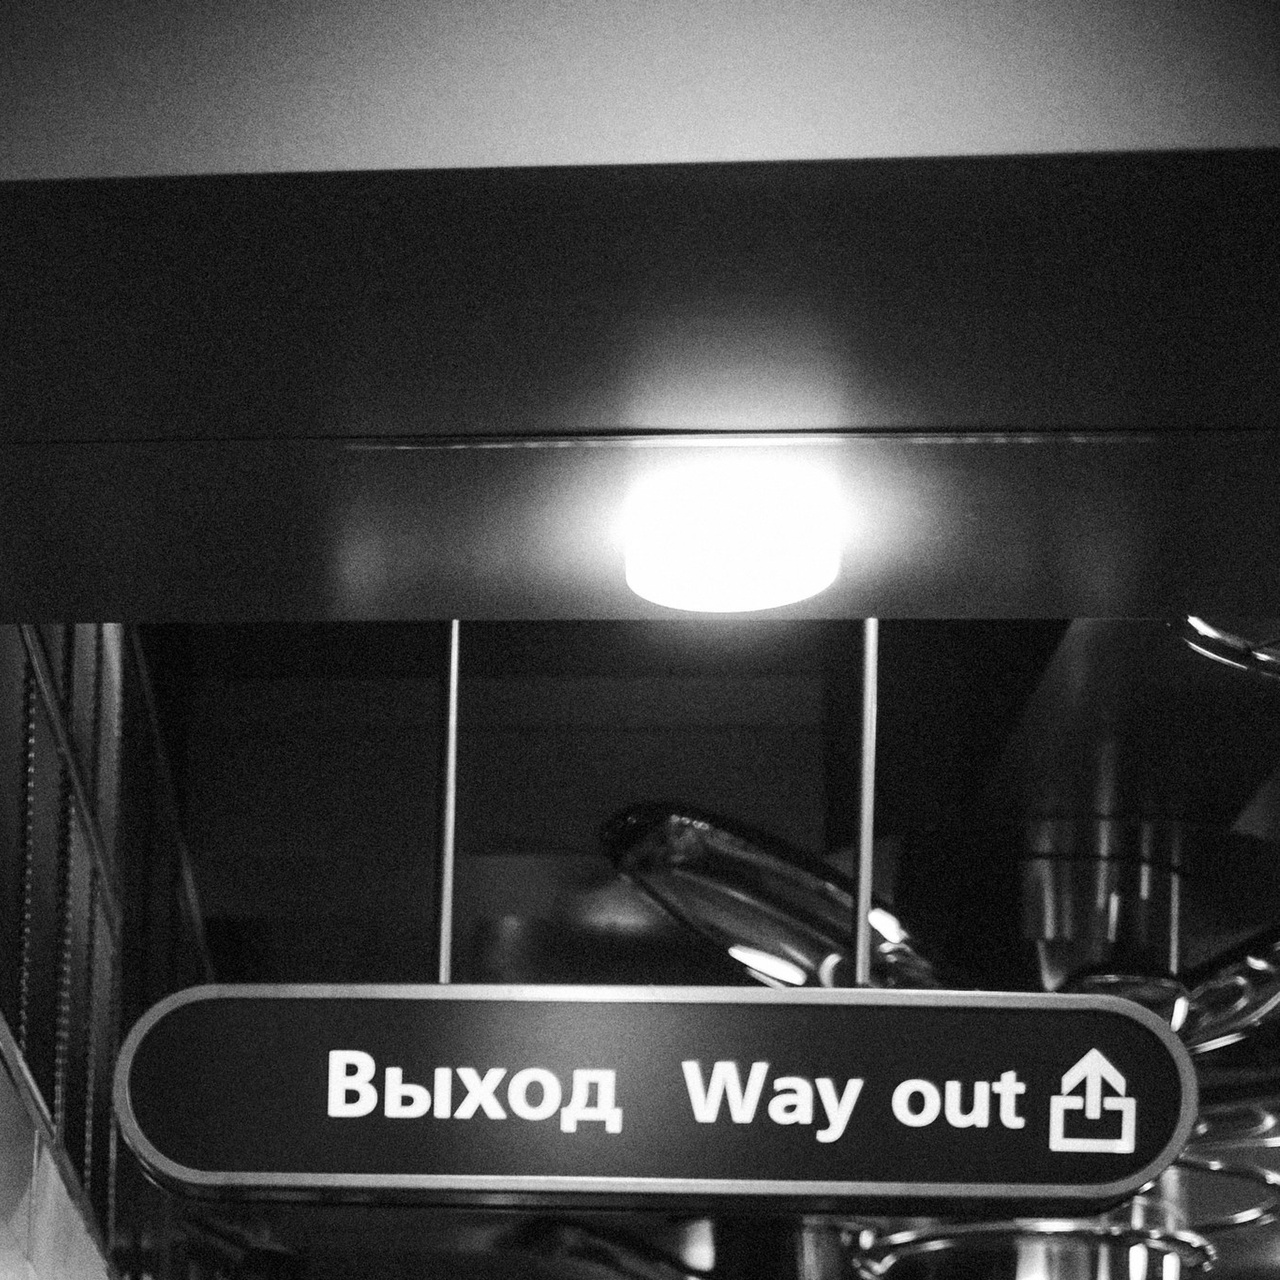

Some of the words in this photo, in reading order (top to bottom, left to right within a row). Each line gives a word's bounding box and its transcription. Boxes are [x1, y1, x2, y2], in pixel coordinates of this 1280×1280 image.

[326, 1048, 623, 1135] Выход
[678, 1056, 865, 1144] Way
[891, 1070, 1027, 1130] out
